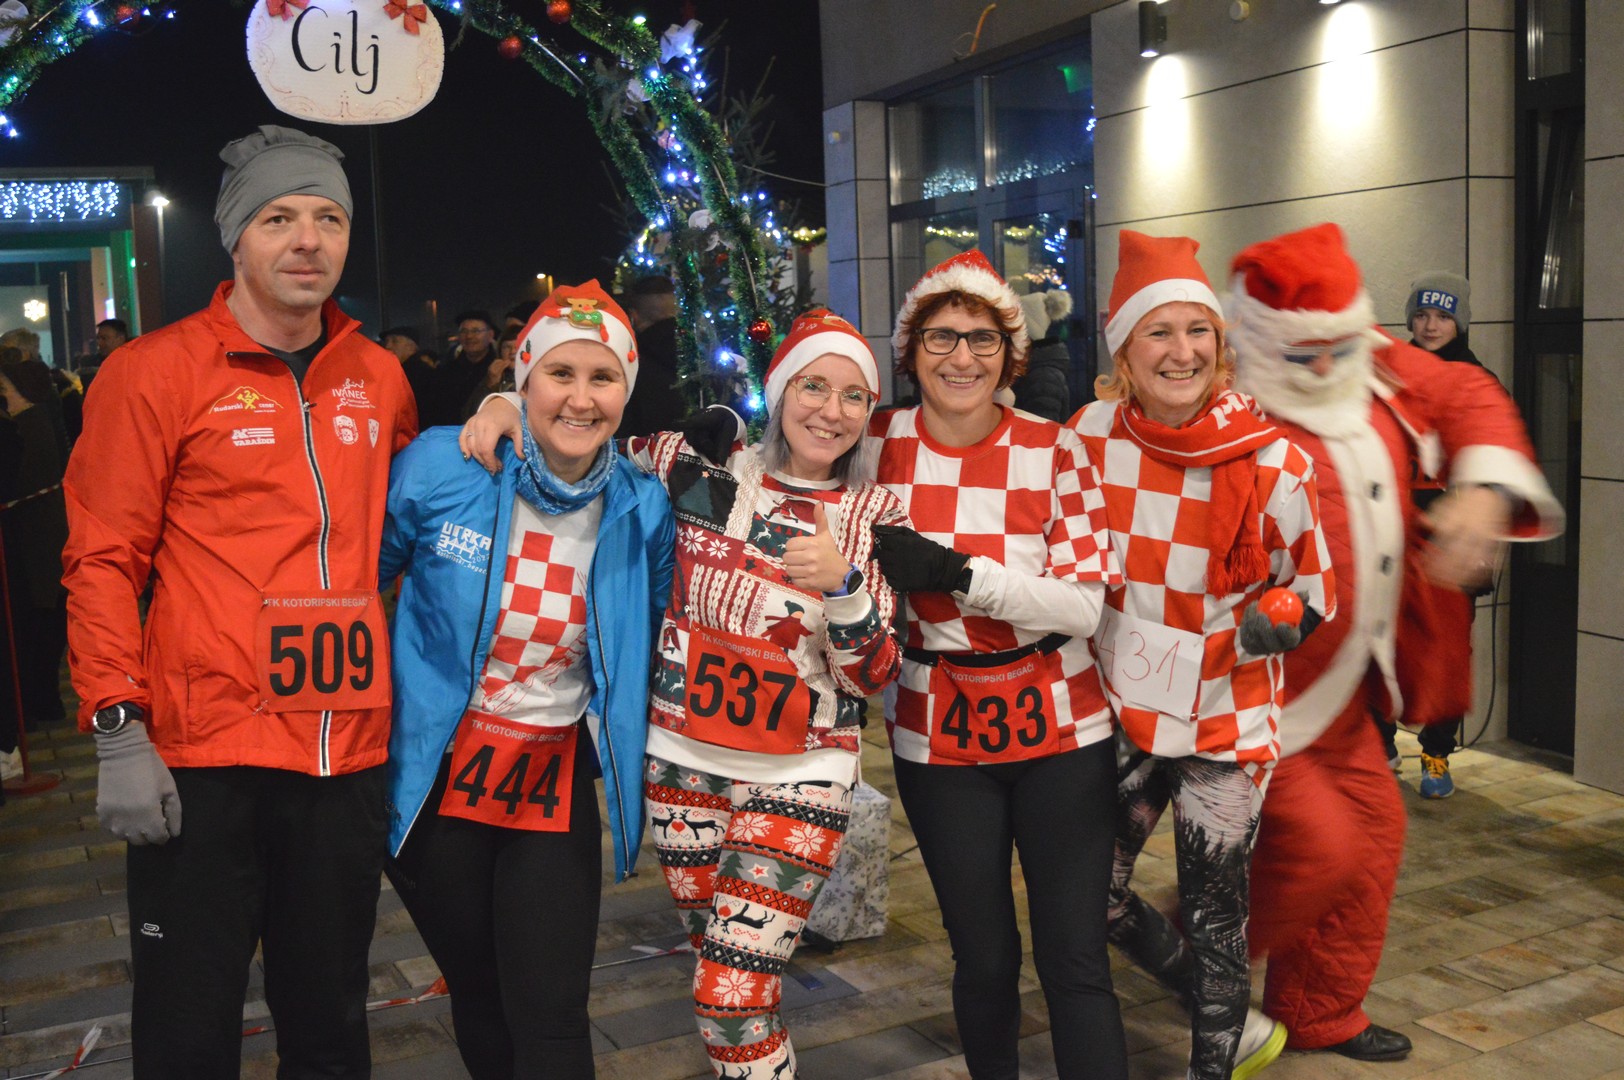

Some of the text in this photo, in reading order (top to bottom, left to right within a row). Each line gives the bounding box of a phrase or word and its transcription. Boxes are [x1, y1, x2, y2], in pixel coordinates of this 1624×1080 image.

[291, 5, 379, 94] Cilj
[1421, 291, 1454, 309] EPIC
[331, 388, 367, 400] IVANEC
[282, 597, 340, 608] KOTORIPSKI
[269, 619, 374, 697] 509
[701, 633, 713, 644] TK
[713, 636, 761, 658] KOTORIPSKI
[1098, 616, 1180, 693] 431
[689, 652, 797, 732] 537
[950, 672, 1005, 684] KOTORIPSKI
[471, 719, 485, 731] TK
[484, 723, 538, 742] KOTORIPSKI
[940, 685, 1047, 754] 433
[453, 744, 562, 819] 444
